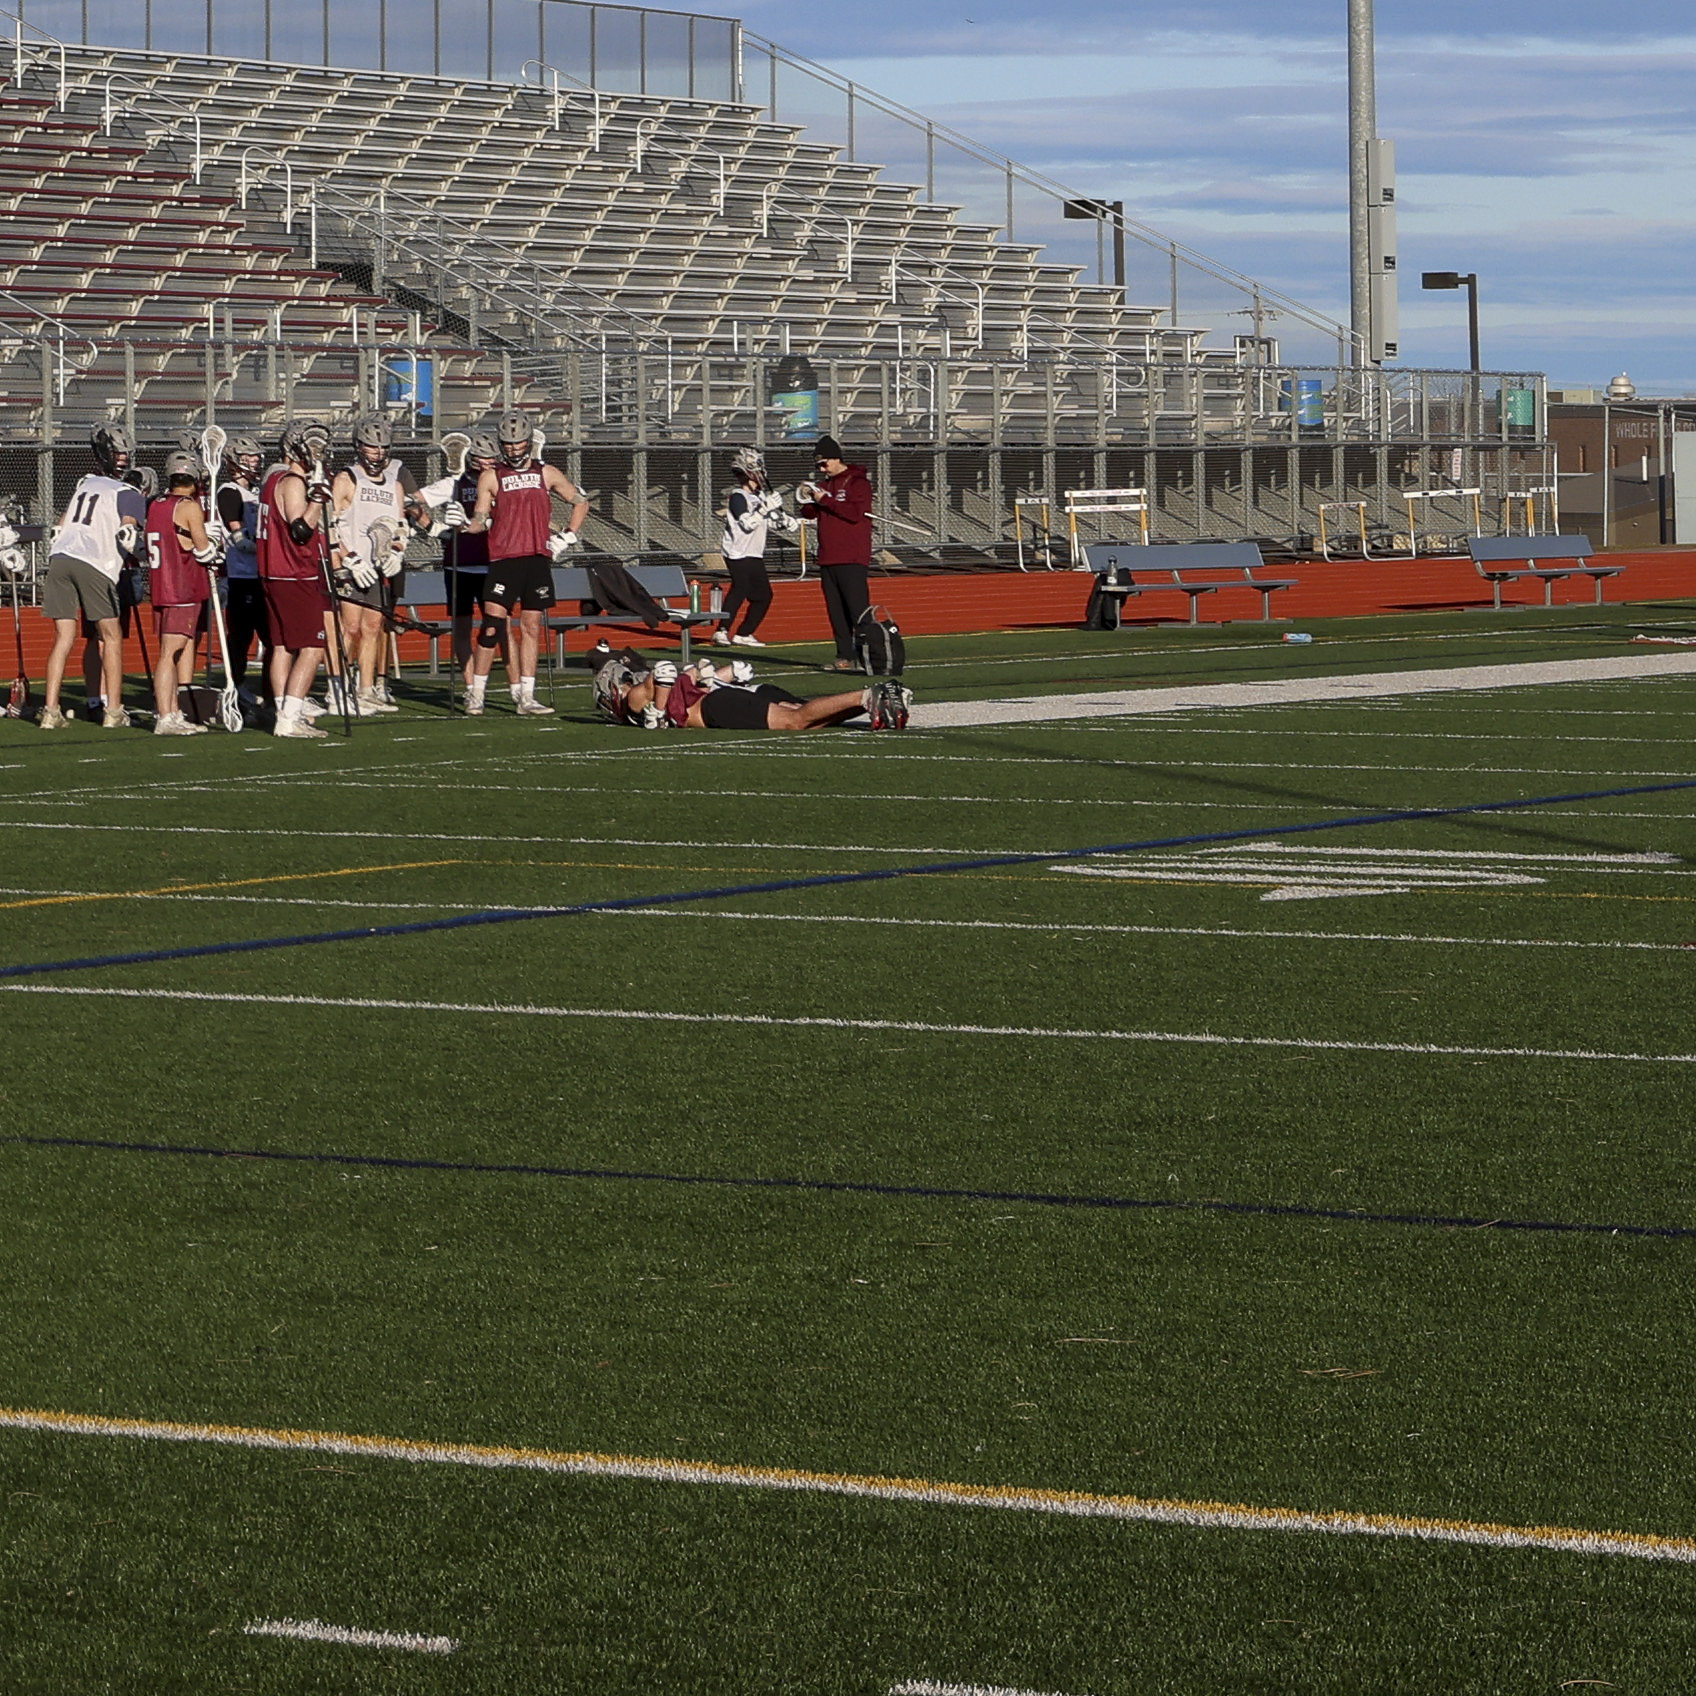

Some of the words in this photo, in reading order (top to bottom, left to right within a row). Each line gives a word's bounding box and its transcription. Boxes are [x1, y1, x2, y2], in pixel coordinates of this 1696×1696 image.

[501, 473, 541, 485] DULUTH
[72, 492, 99, 526] 11
[147, 532, 161, 569] 5
